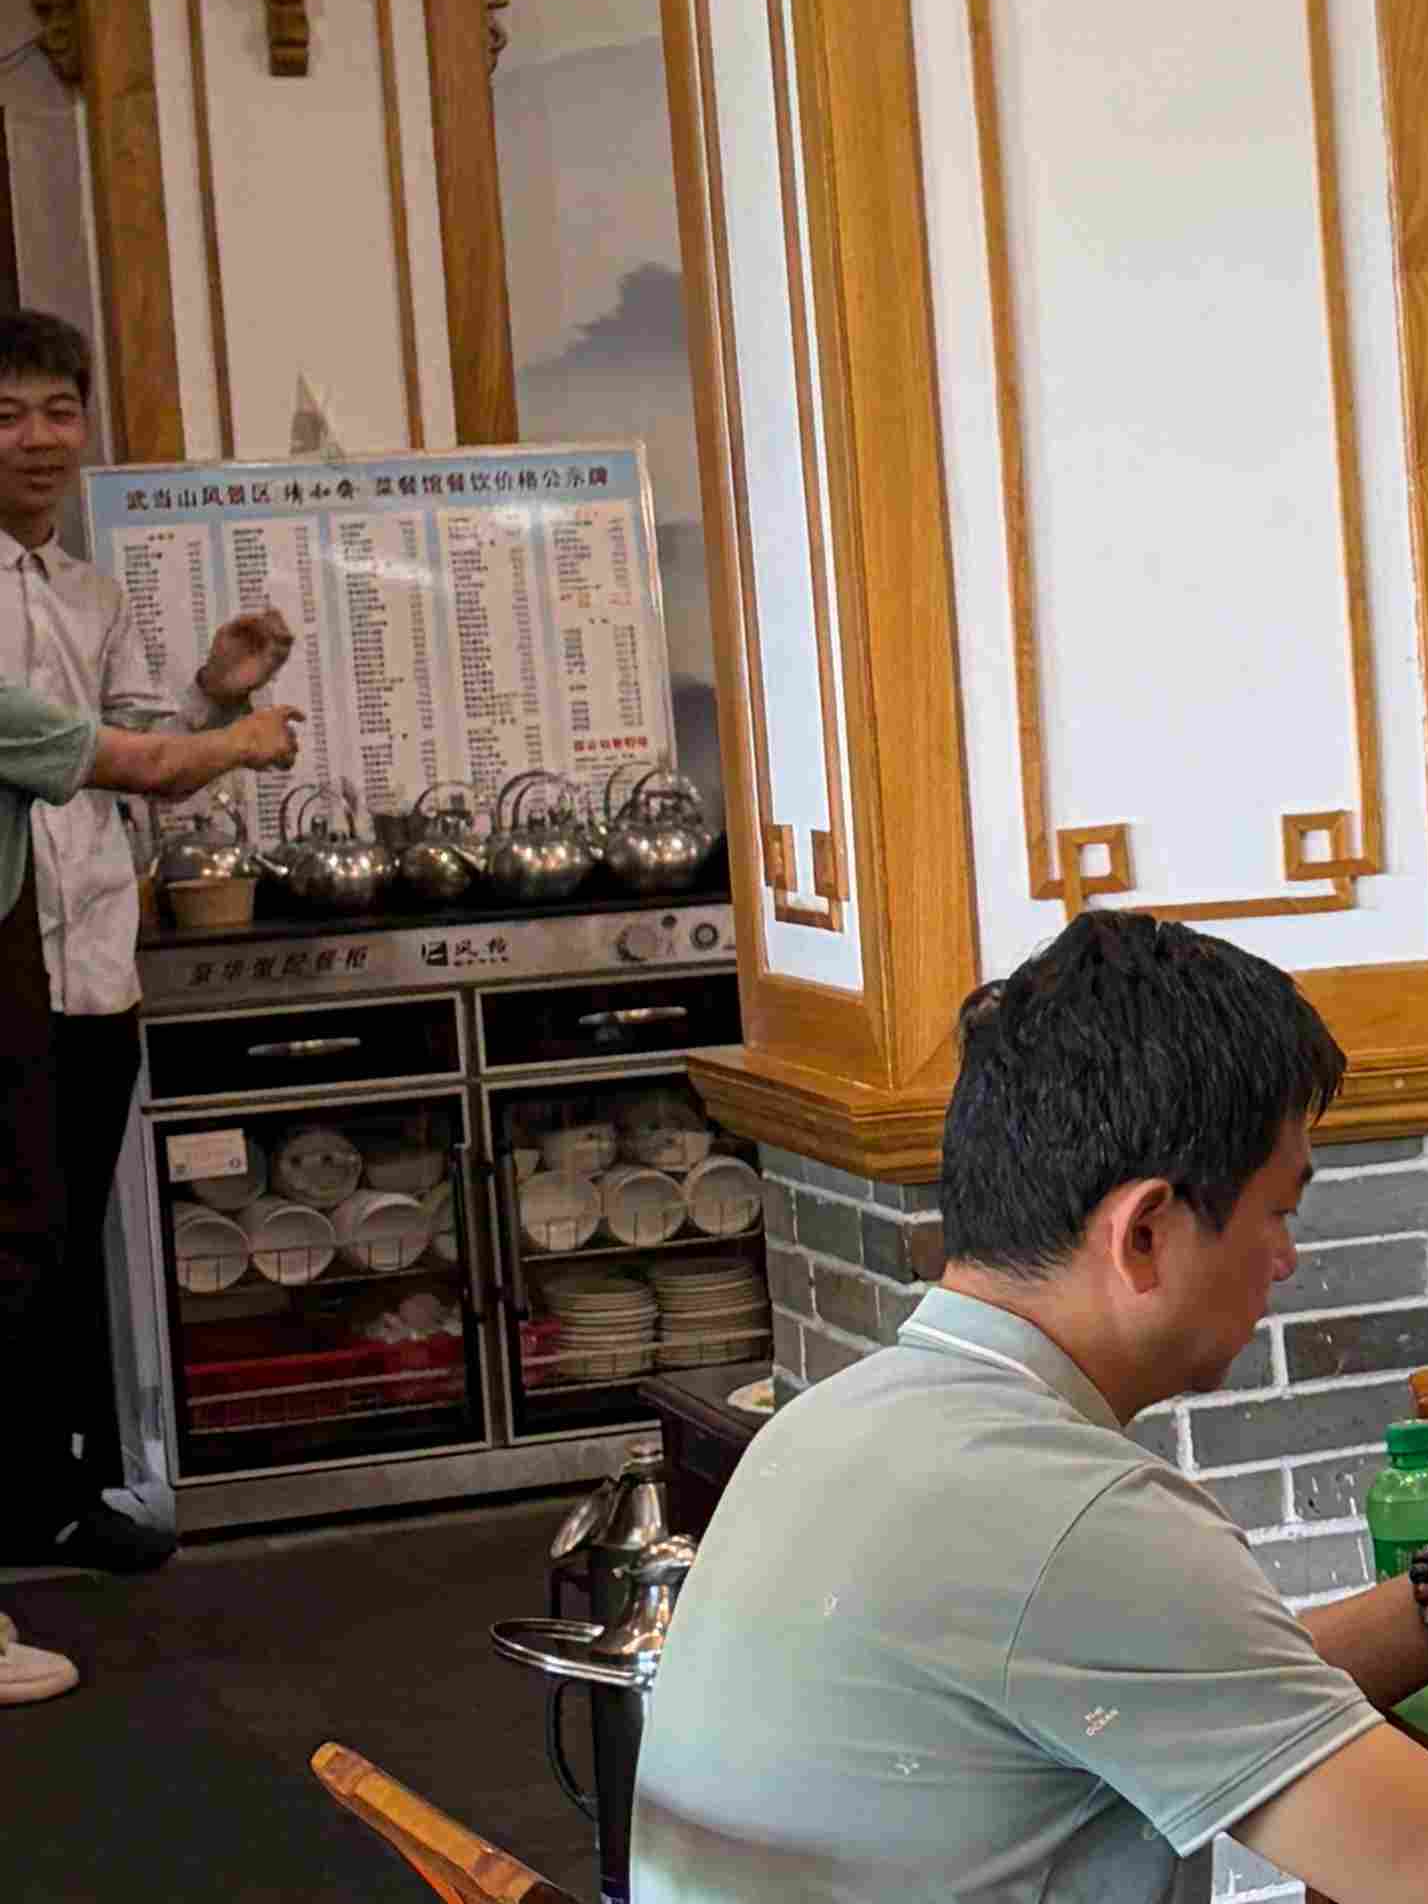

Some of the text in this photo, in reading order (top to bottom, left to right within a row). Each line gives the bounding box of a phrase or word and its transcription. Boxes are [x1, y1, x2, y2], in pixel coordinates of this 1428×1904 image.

[127, 483, 272, 511] 武当山风景区
